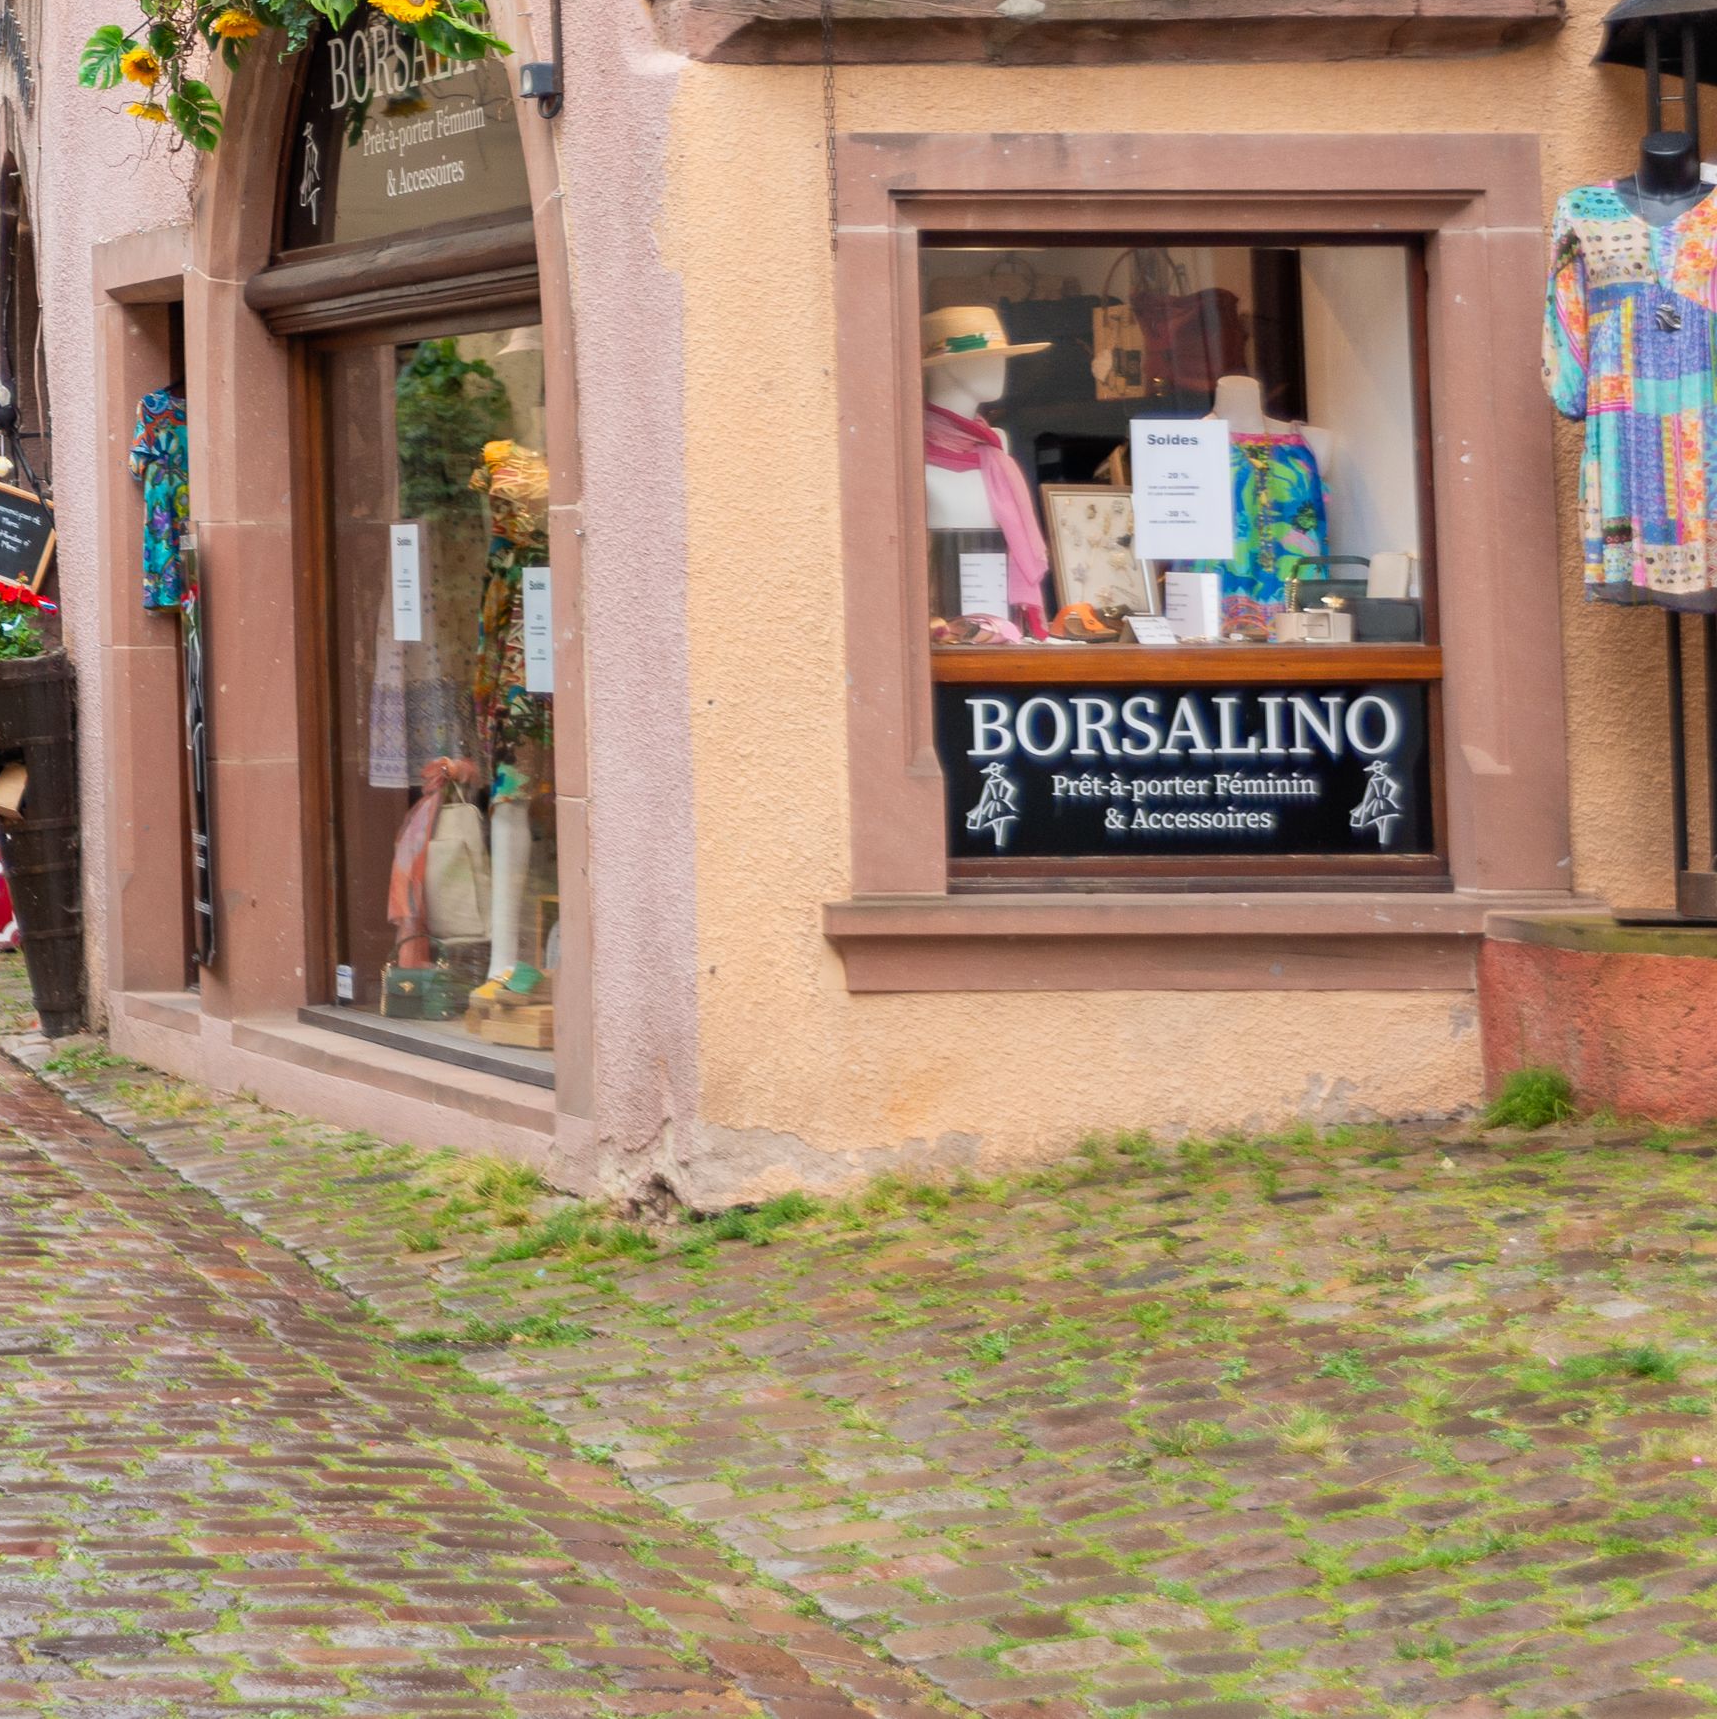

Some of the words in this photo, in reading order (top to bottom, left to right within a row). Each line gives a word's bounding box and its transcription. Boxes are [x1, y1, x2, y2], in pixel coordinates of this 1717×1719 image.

[327, 24, 477, 110] BORSAL
[363, 119, 435, 157] Prêt-à-porter
[435, 99, 486, 139] Féminin
[386, 168, 397, 198] &
[397, 154, 465, 196] Accessoires
[1147, 433, 1199, 446] Soldes
[965, 695, 1398, 757] BORSALINO
[1051, 774, 1211, 802] Prêt-à-porter
[1214, 773, 1318, 796] Féminin
[1104, 808, 1126, 830] &
[1131, 806, 1273, 830] Accessoires
